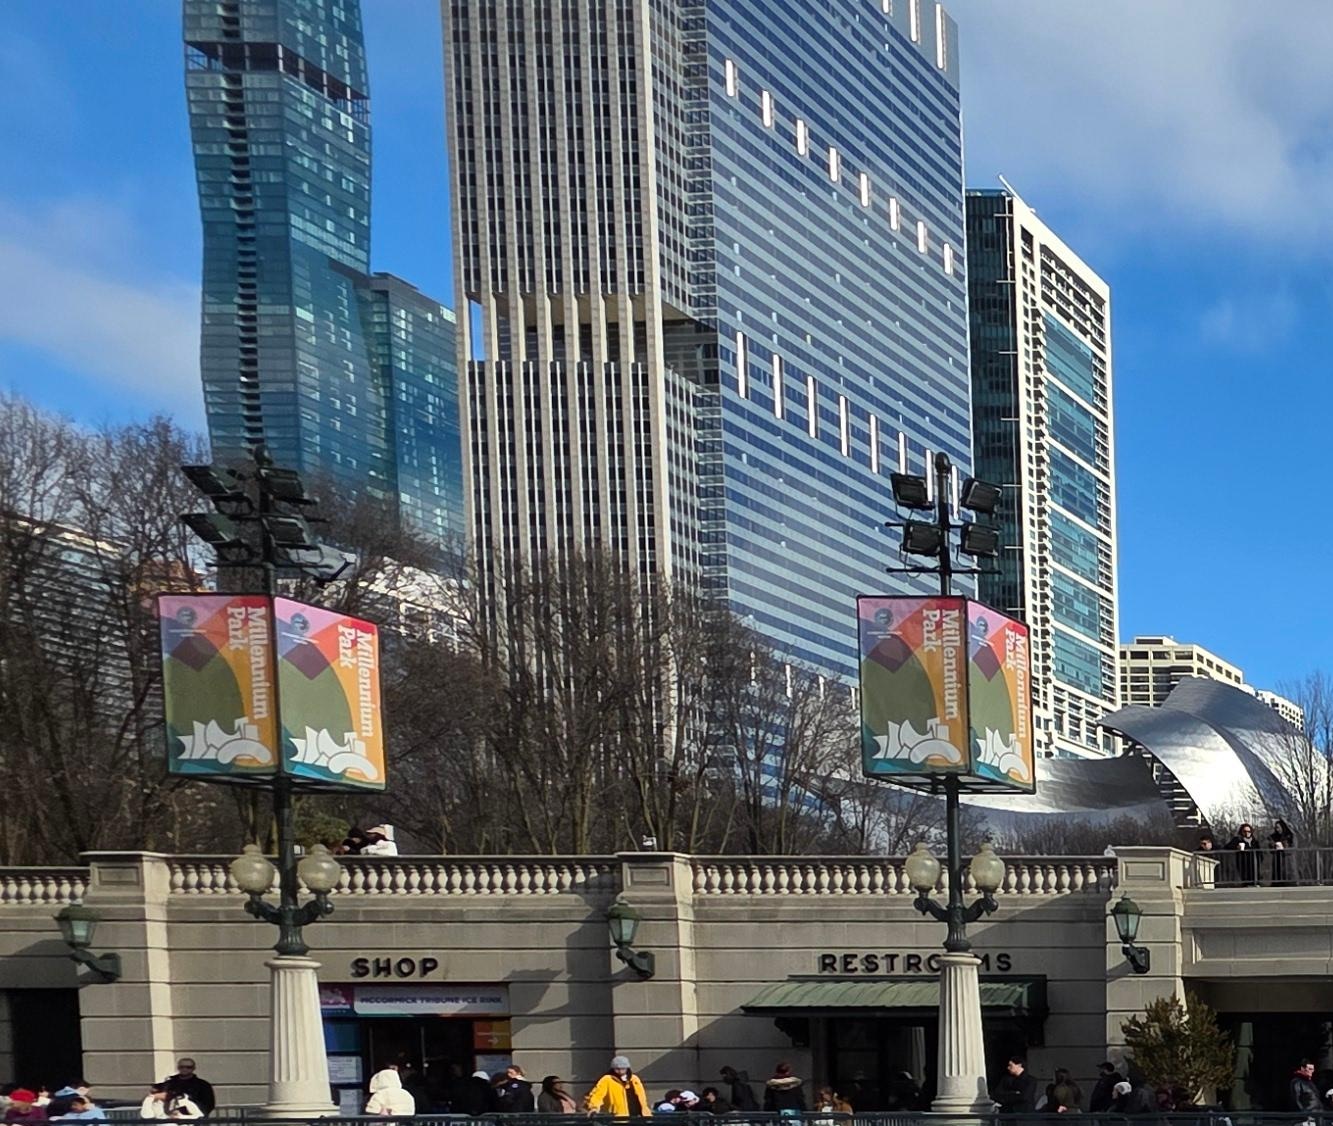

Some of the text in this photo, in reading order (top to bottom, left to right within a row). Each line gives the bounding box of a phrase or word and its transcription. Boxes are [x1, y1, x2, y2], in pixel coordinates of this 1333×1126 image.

[227, 606, 248, 651] Park
[337, 625, 356, 669] Park
[922, 609, 941, 653] Park
[1005, 628, 1016, 670] Park
[247, 606, 270, 720] Millennium
[356, 628, 374, 737] Millennium
[942, 609, 961, 720] Millennium
[1015, 633, 1029, 738] Millennium
[352, 958, 438, 977] SHOP
